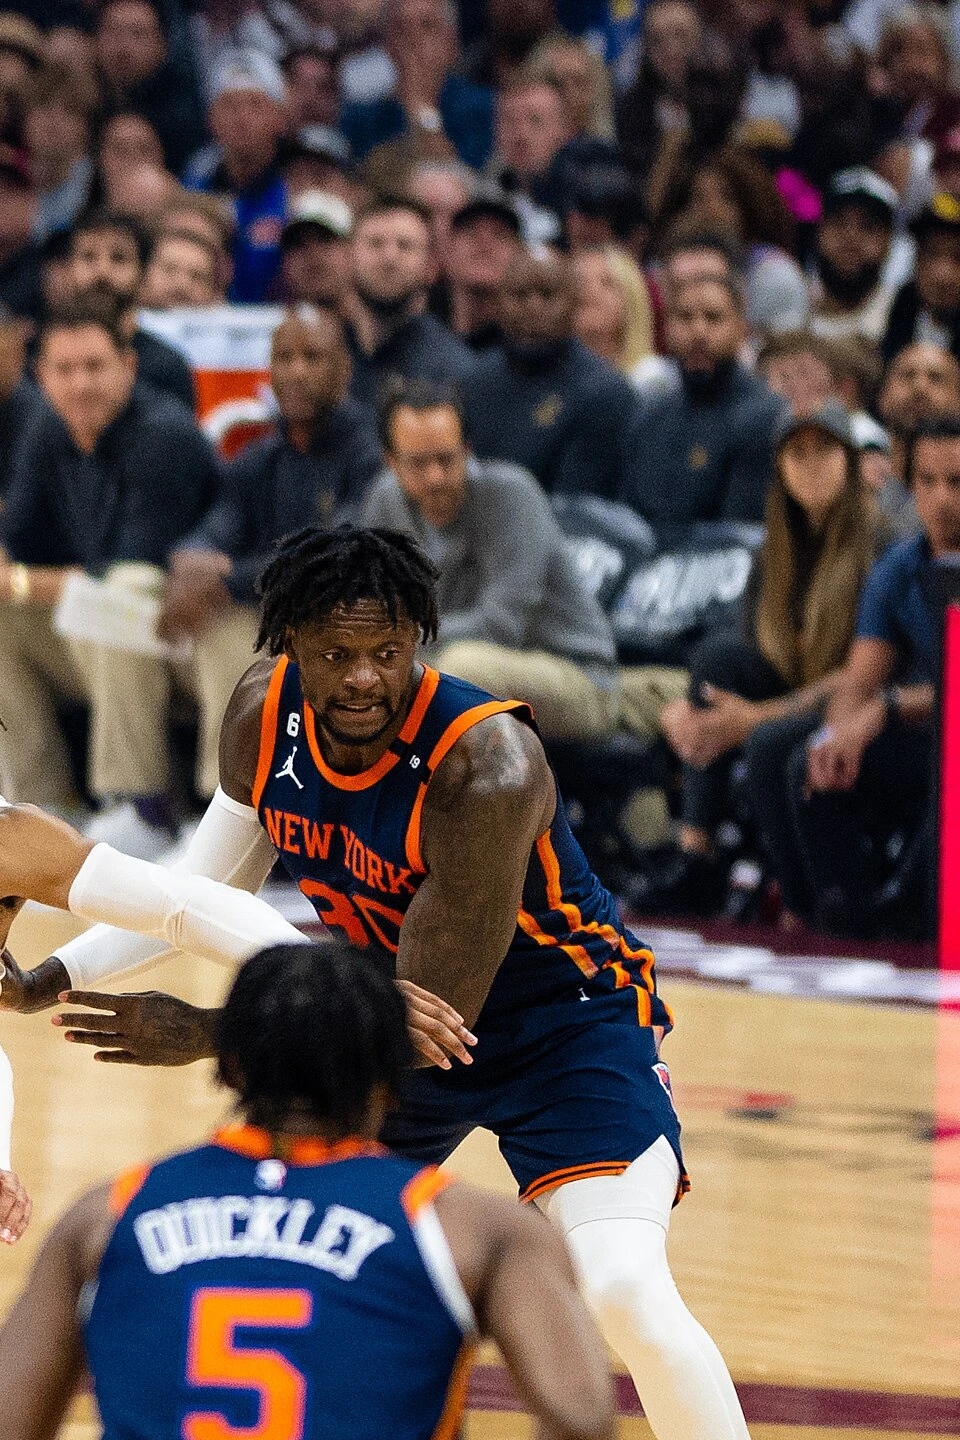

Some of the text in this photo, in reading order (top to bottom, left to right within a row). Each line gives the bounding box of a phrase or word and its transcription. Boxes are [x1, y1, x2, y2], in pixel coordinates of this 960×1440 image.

[287, 712, 301, 737] 6
[264, 807, 417, 894] NEW YORK
[133, 1195, 395, 1281] QUICKLEY
